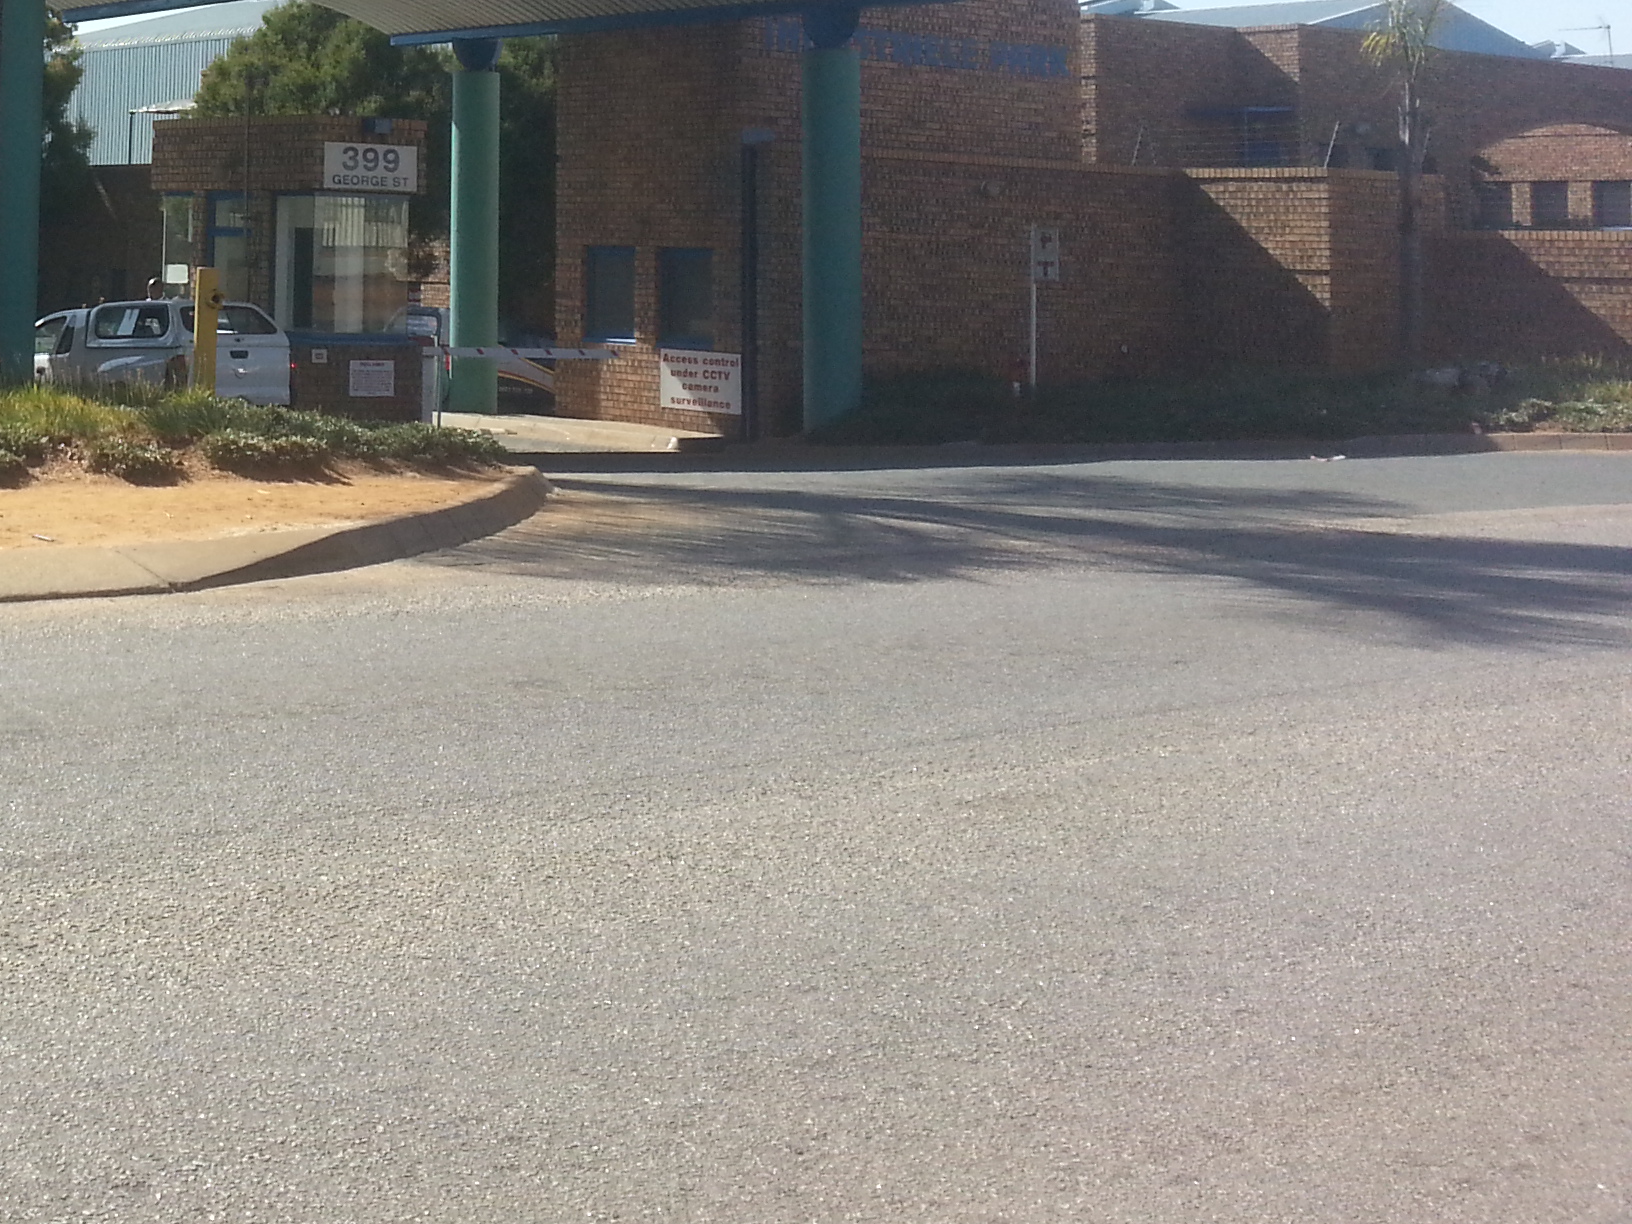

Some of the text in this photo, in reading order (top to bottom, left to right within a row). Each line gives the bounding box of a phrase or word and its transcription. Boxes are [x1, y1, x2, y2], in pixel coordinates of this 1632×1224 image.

[342, 146, 400, 173] 399
[332, 174, 410, 188] GEORGE ST
[663, 353, 739, 368] Access control
[670, 369, 731, 381] under CCTV
[682, 382, 720, 393] camera
[670, 396, 731, 410] surveillance
